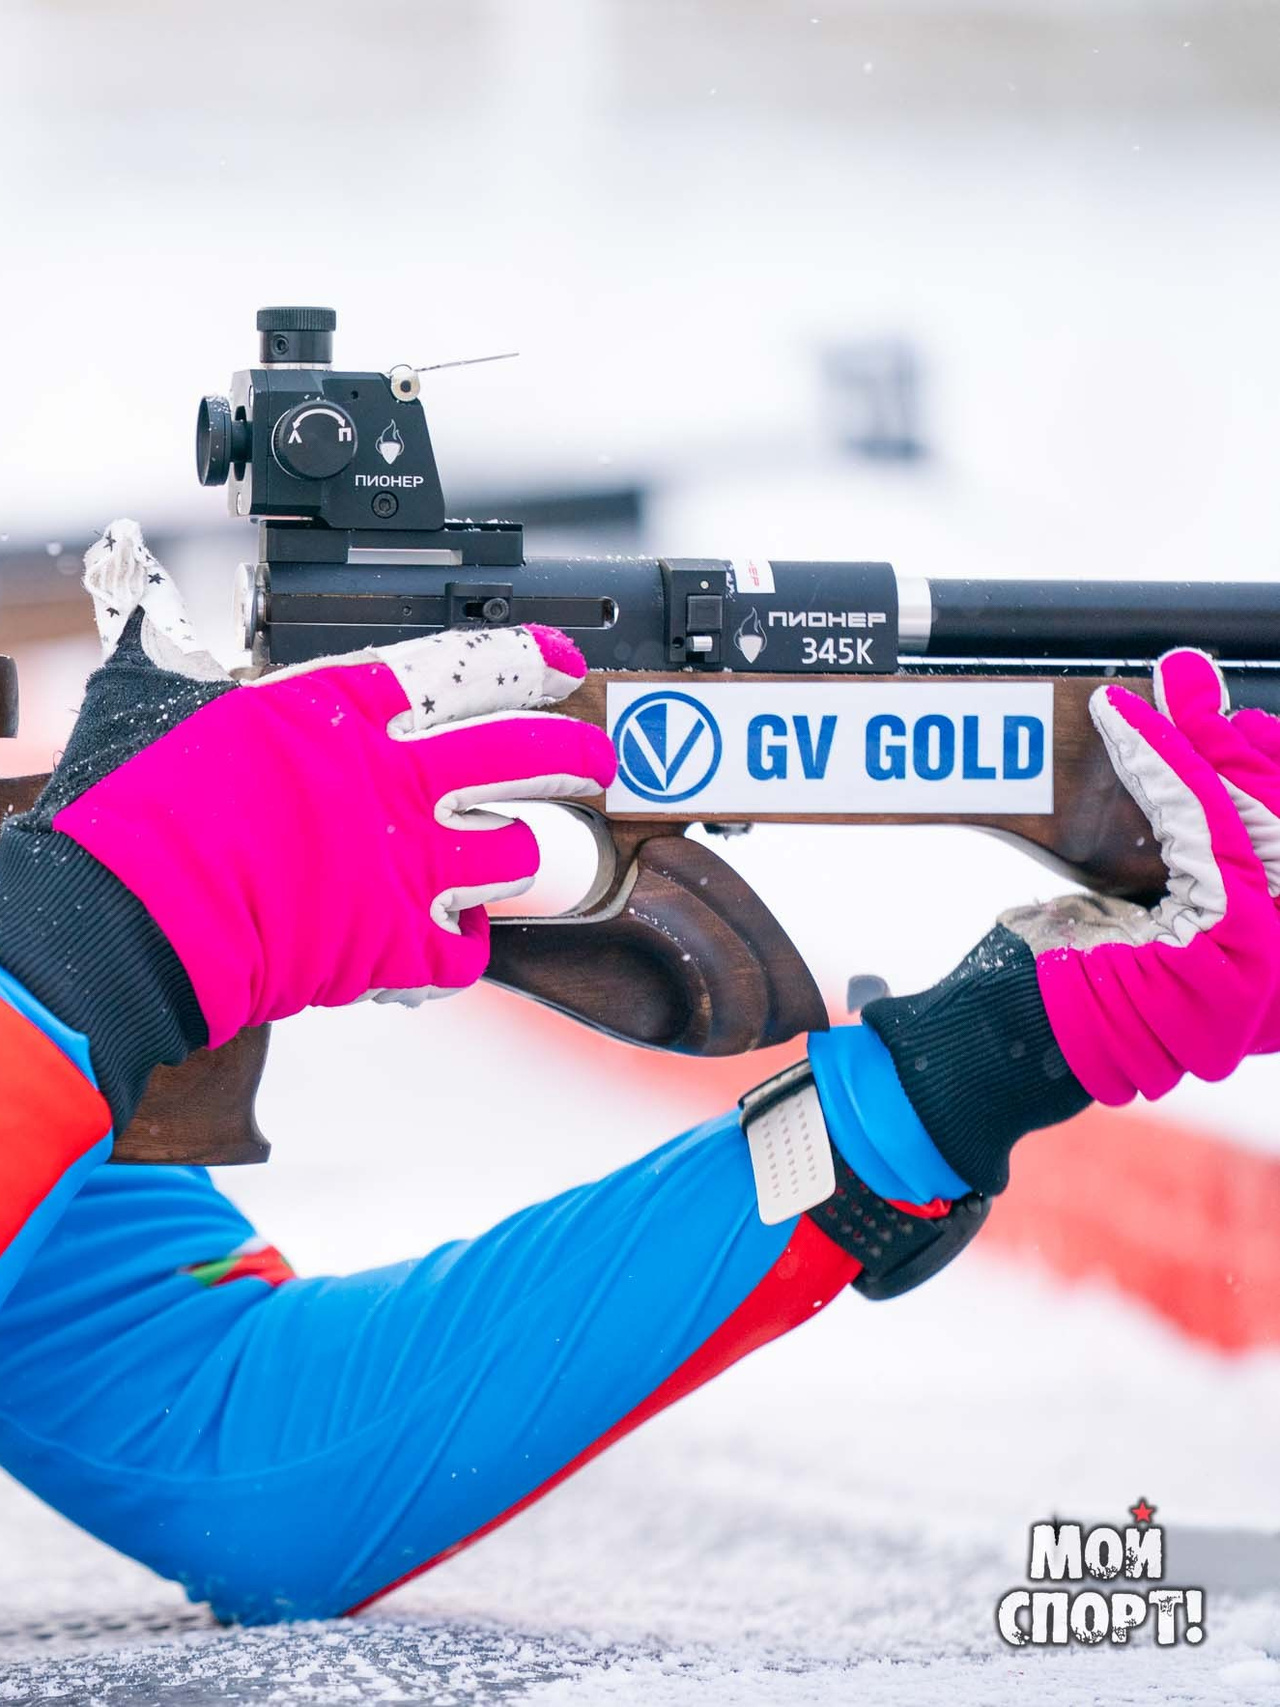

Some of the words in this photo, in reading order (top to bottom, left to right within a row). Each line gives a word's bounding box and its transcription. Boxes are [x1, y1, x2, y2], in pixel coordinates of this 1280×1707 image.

[355, 474, 424, 489] ПИОНЕР
[768, 611, 887, 628] ПИОНЕР
[746, 713, 838, 781] GV
[865, 713, 1045, 781] GOLD
